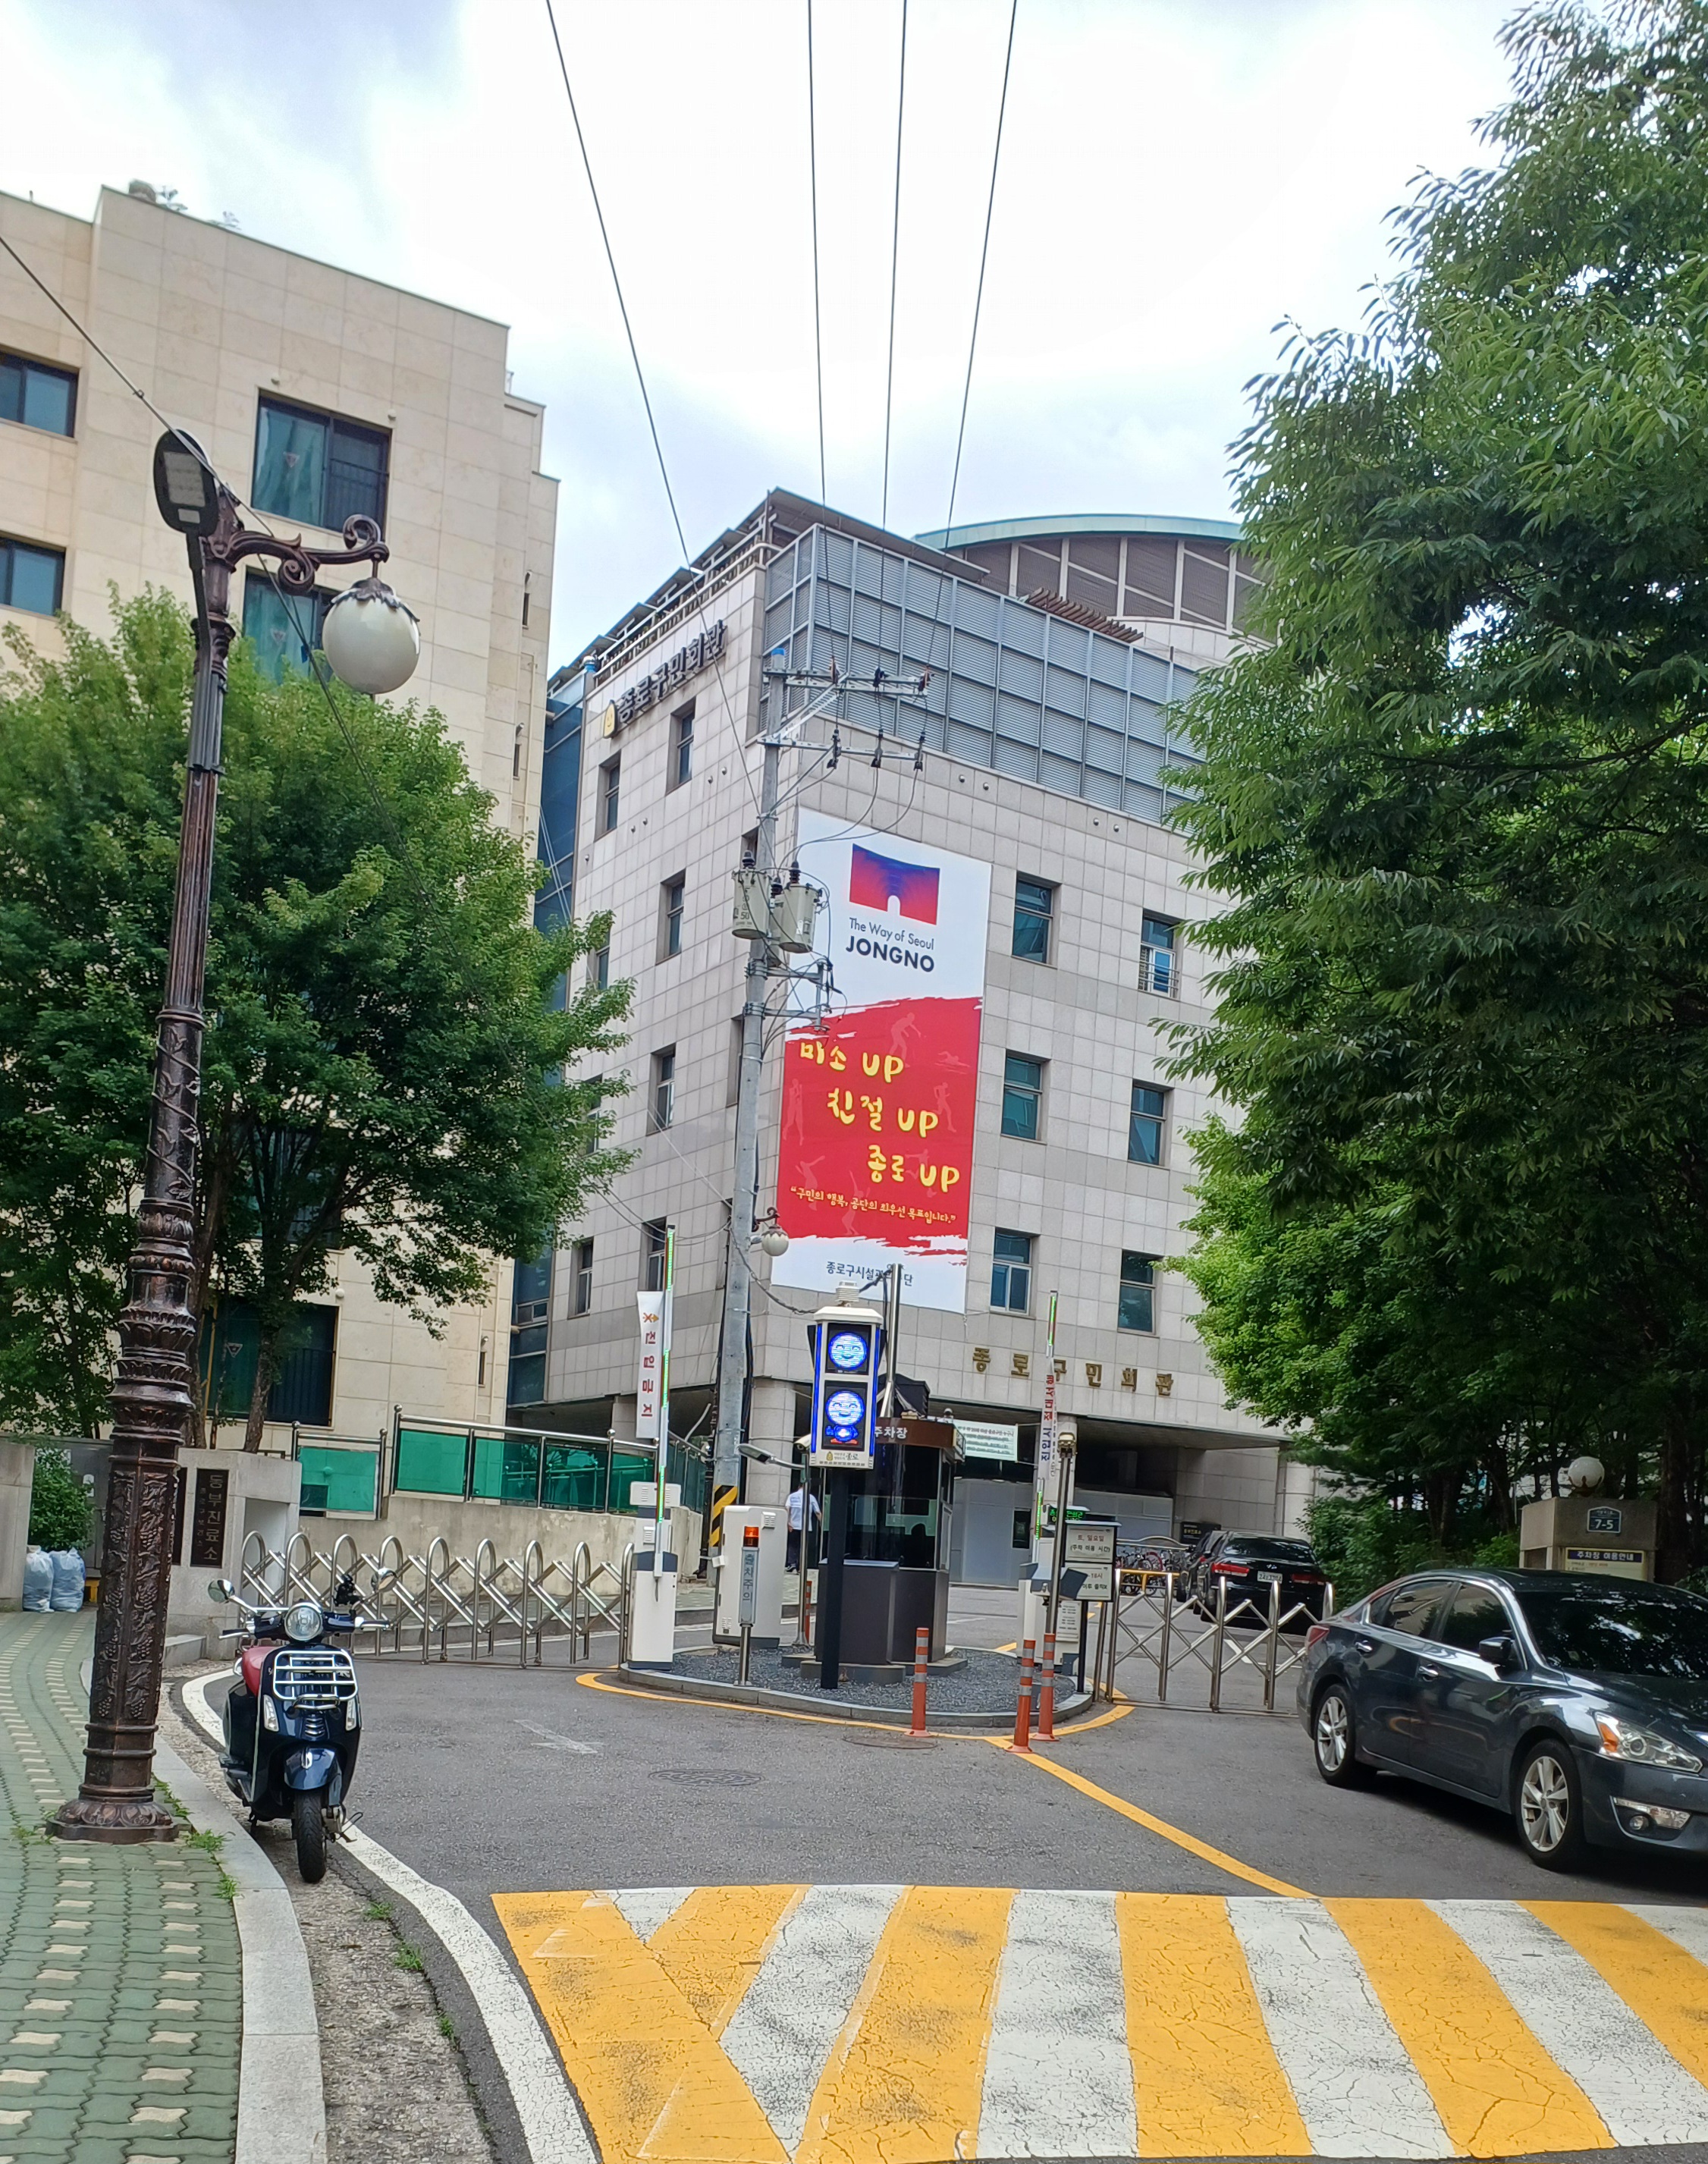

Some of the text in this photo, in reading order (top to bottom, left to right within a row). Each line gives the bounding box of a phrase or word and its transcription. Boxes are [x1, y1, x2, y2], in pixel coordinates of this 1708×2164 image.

[617, 619, 727, 724] 종로구민회관
[845, 935, 935, 973] JONGNO
[849, 917, 934, 950] The Way of Seoul
[800, 1041, 904, 1083] 미소 UP
[827, 1088, 938, 1138] 친절 UP
[868, 1145, 959, 1192] 종로 UP
[827, 1193, 849, 1208] 행복,
[850, 1198, 878, 1211] 공단의
[879, 1203, 906, 1218] 최우선
[641, 1331, 656, 1417] 진입금지
[972, 1347, 1174, 1396] 종로구민회관
[874, 1427, 908, 1439] 주차장
[203, 1475, 224, 1560] 동부진료소
[1594, 1519, 1614, 1530] 7-5
[1577, 1550, 1634, 1561] 주차장 이용안내
